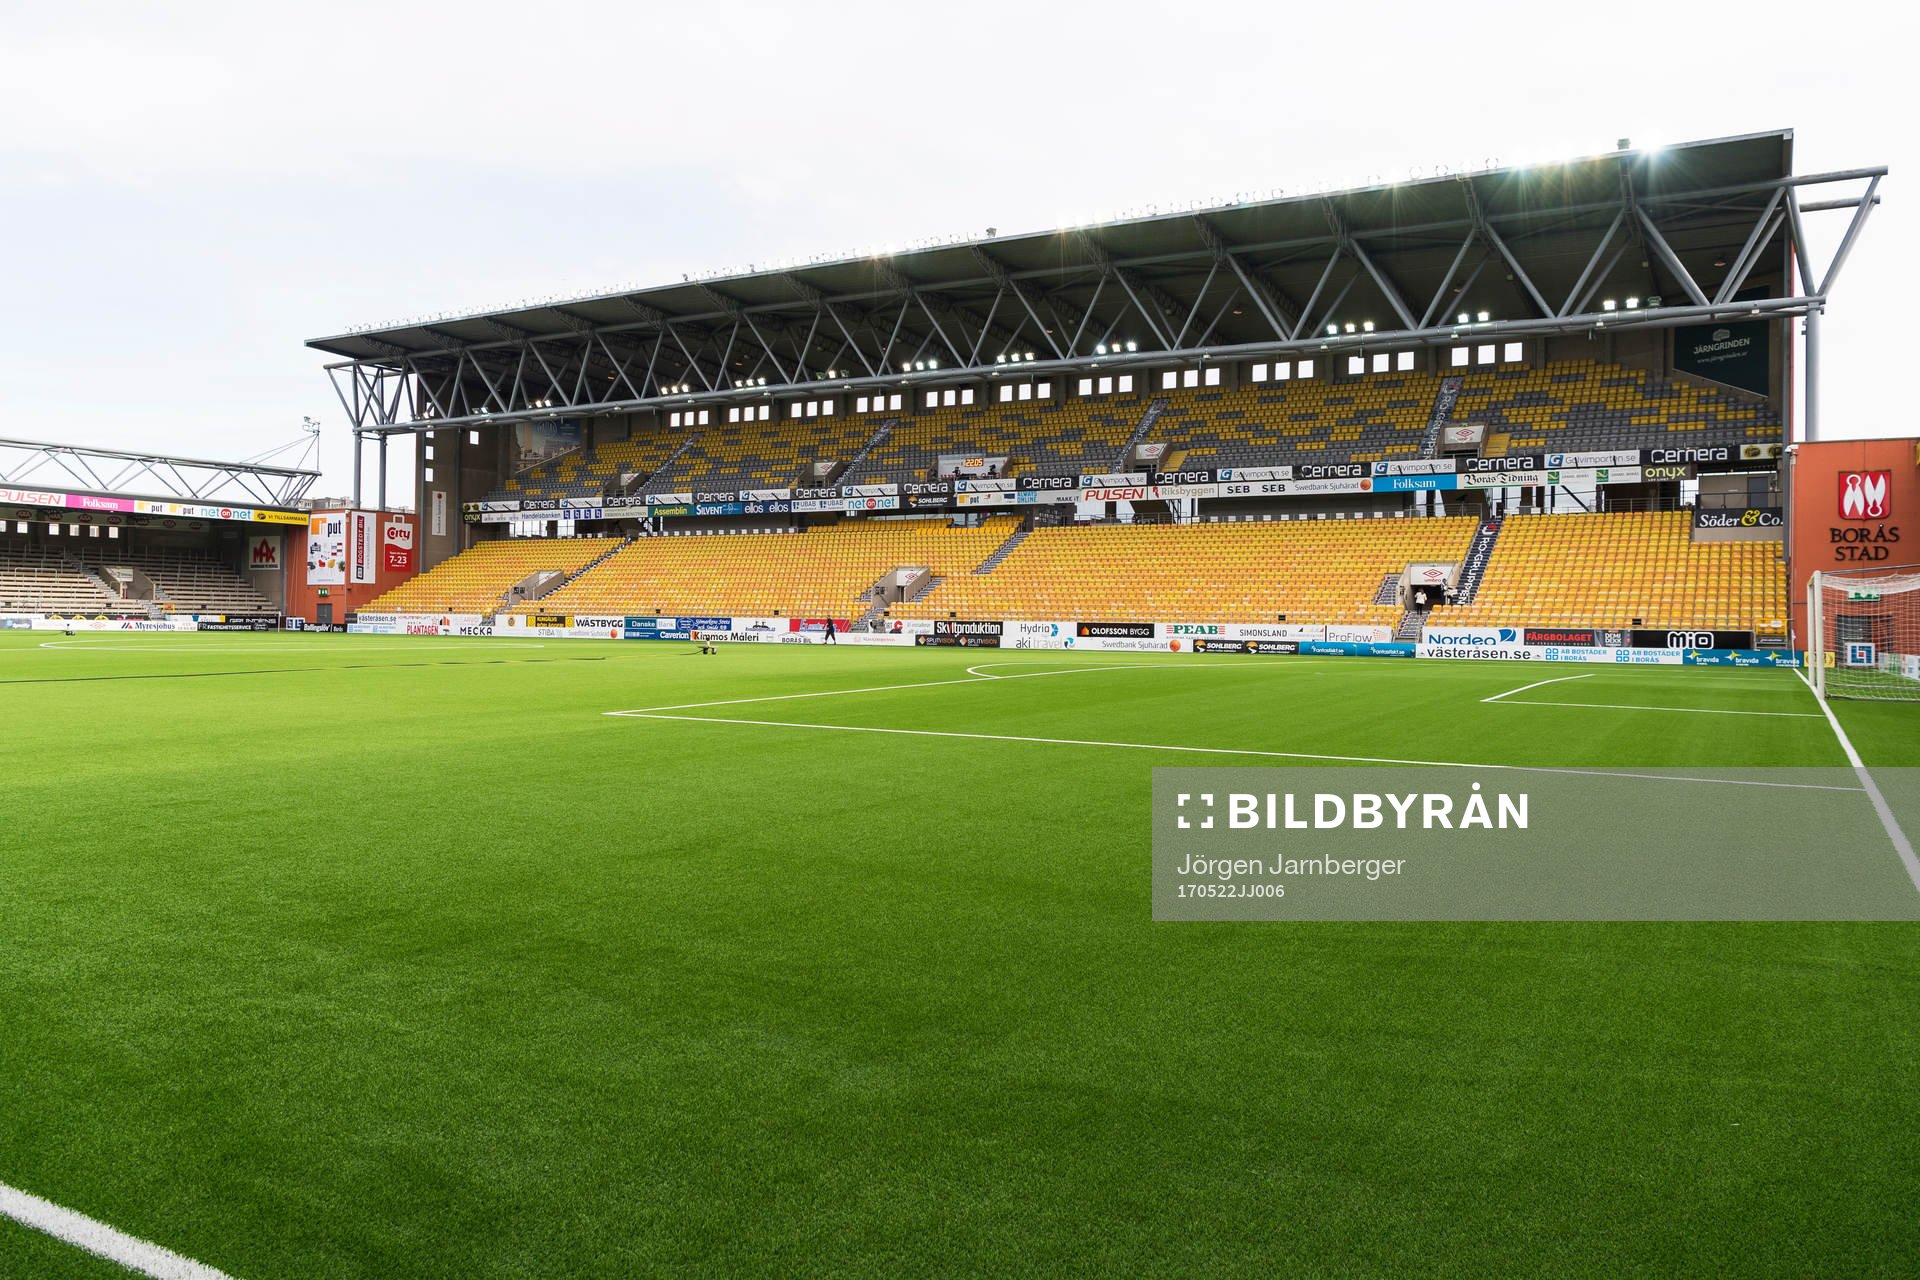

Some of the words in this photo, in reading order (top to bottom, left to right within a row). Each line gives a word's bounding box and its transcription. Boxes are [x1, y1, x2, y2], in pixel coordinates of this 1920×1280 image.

[1645, 465, 1687, 479] onyx
[1393, 479, 1436, 489] Folksam
[1497, 473, 1539, 485] Tidning
[1161, 486, 1215, 497] Riksbyggen
[1226, 485, 1251, 494] SEB
[1261, 484, 1286, 493] SEB
[1294, 482, 1329, 491] Swedbank
[1084, 488, 1145, 501] PULSEN
[82, 498, 119, 510] Folksam
[151, 503, 163, 513] put
[848, 500, 866, 510] net
[875, 498, 895, 509] net
[183, 505, 194, 515] put
[201, 507, 219, 518] net
[232, 509, 251, 520] net
[521, 511, 562, 520] Handelsbanken
[653, 507, 688, 516] Assemblin
[696, 505, 723, 516] SILVENT
[463, 514, 481, 522] onyx
[1698, 513, 1741, 528] Söder
[1740, 509, 1761, 527] &
[327, 520, 342, 538] put
[1829, 523, 1901, 543] BORÅS
[252, 537, 276, 564] MAX
[1834, 546, 1889, 561] STAD
[389, 555, 408, 564] 7-23
[1456, 537, 1490, 605] RO-GRUPPEN
[358, 614, 397, 623] västeråsen.se
[575, 617, 624, 628] WÄSTBYGG
[406, 624, 439, 636] PLANTAGEN
[459, 626, 493, 636] MECKA
[936, 621, 1001, 637] Skyltproduktion
[1091, 627, 1129, 635] OLOFSSON
[1129, 627, 1150, 635] BYGG
[1173, 625, 1218, 635] PEAB
[1239, 629, 1288, 638] SIMONSLAND
[660, 631, 690, 640] Caverion
[694, 631, 728, 641] Kimmos
[730, 632, 759, 642] Måleri
[1328, 632, 1373, 643] ProFlow
[1428, 633, 1497, 645] Nordea
[1525, 630, 1592, 642] FÄRGBOLAGET
[1015, 638, 1031, 649] aki
[1033, 638, 1063, 649] travel
[1102, 639, 1136, 648] Swedbank
[1206, 642, 1242, 650] SOHLBERG
[1258, 643, 1295, 651] SOHLBERG
[1426, 645, 1531, 660] västeråsen.se
[1696, 656, 1720, 664] bravida
[1735, 657, 1760, 665] bravida
